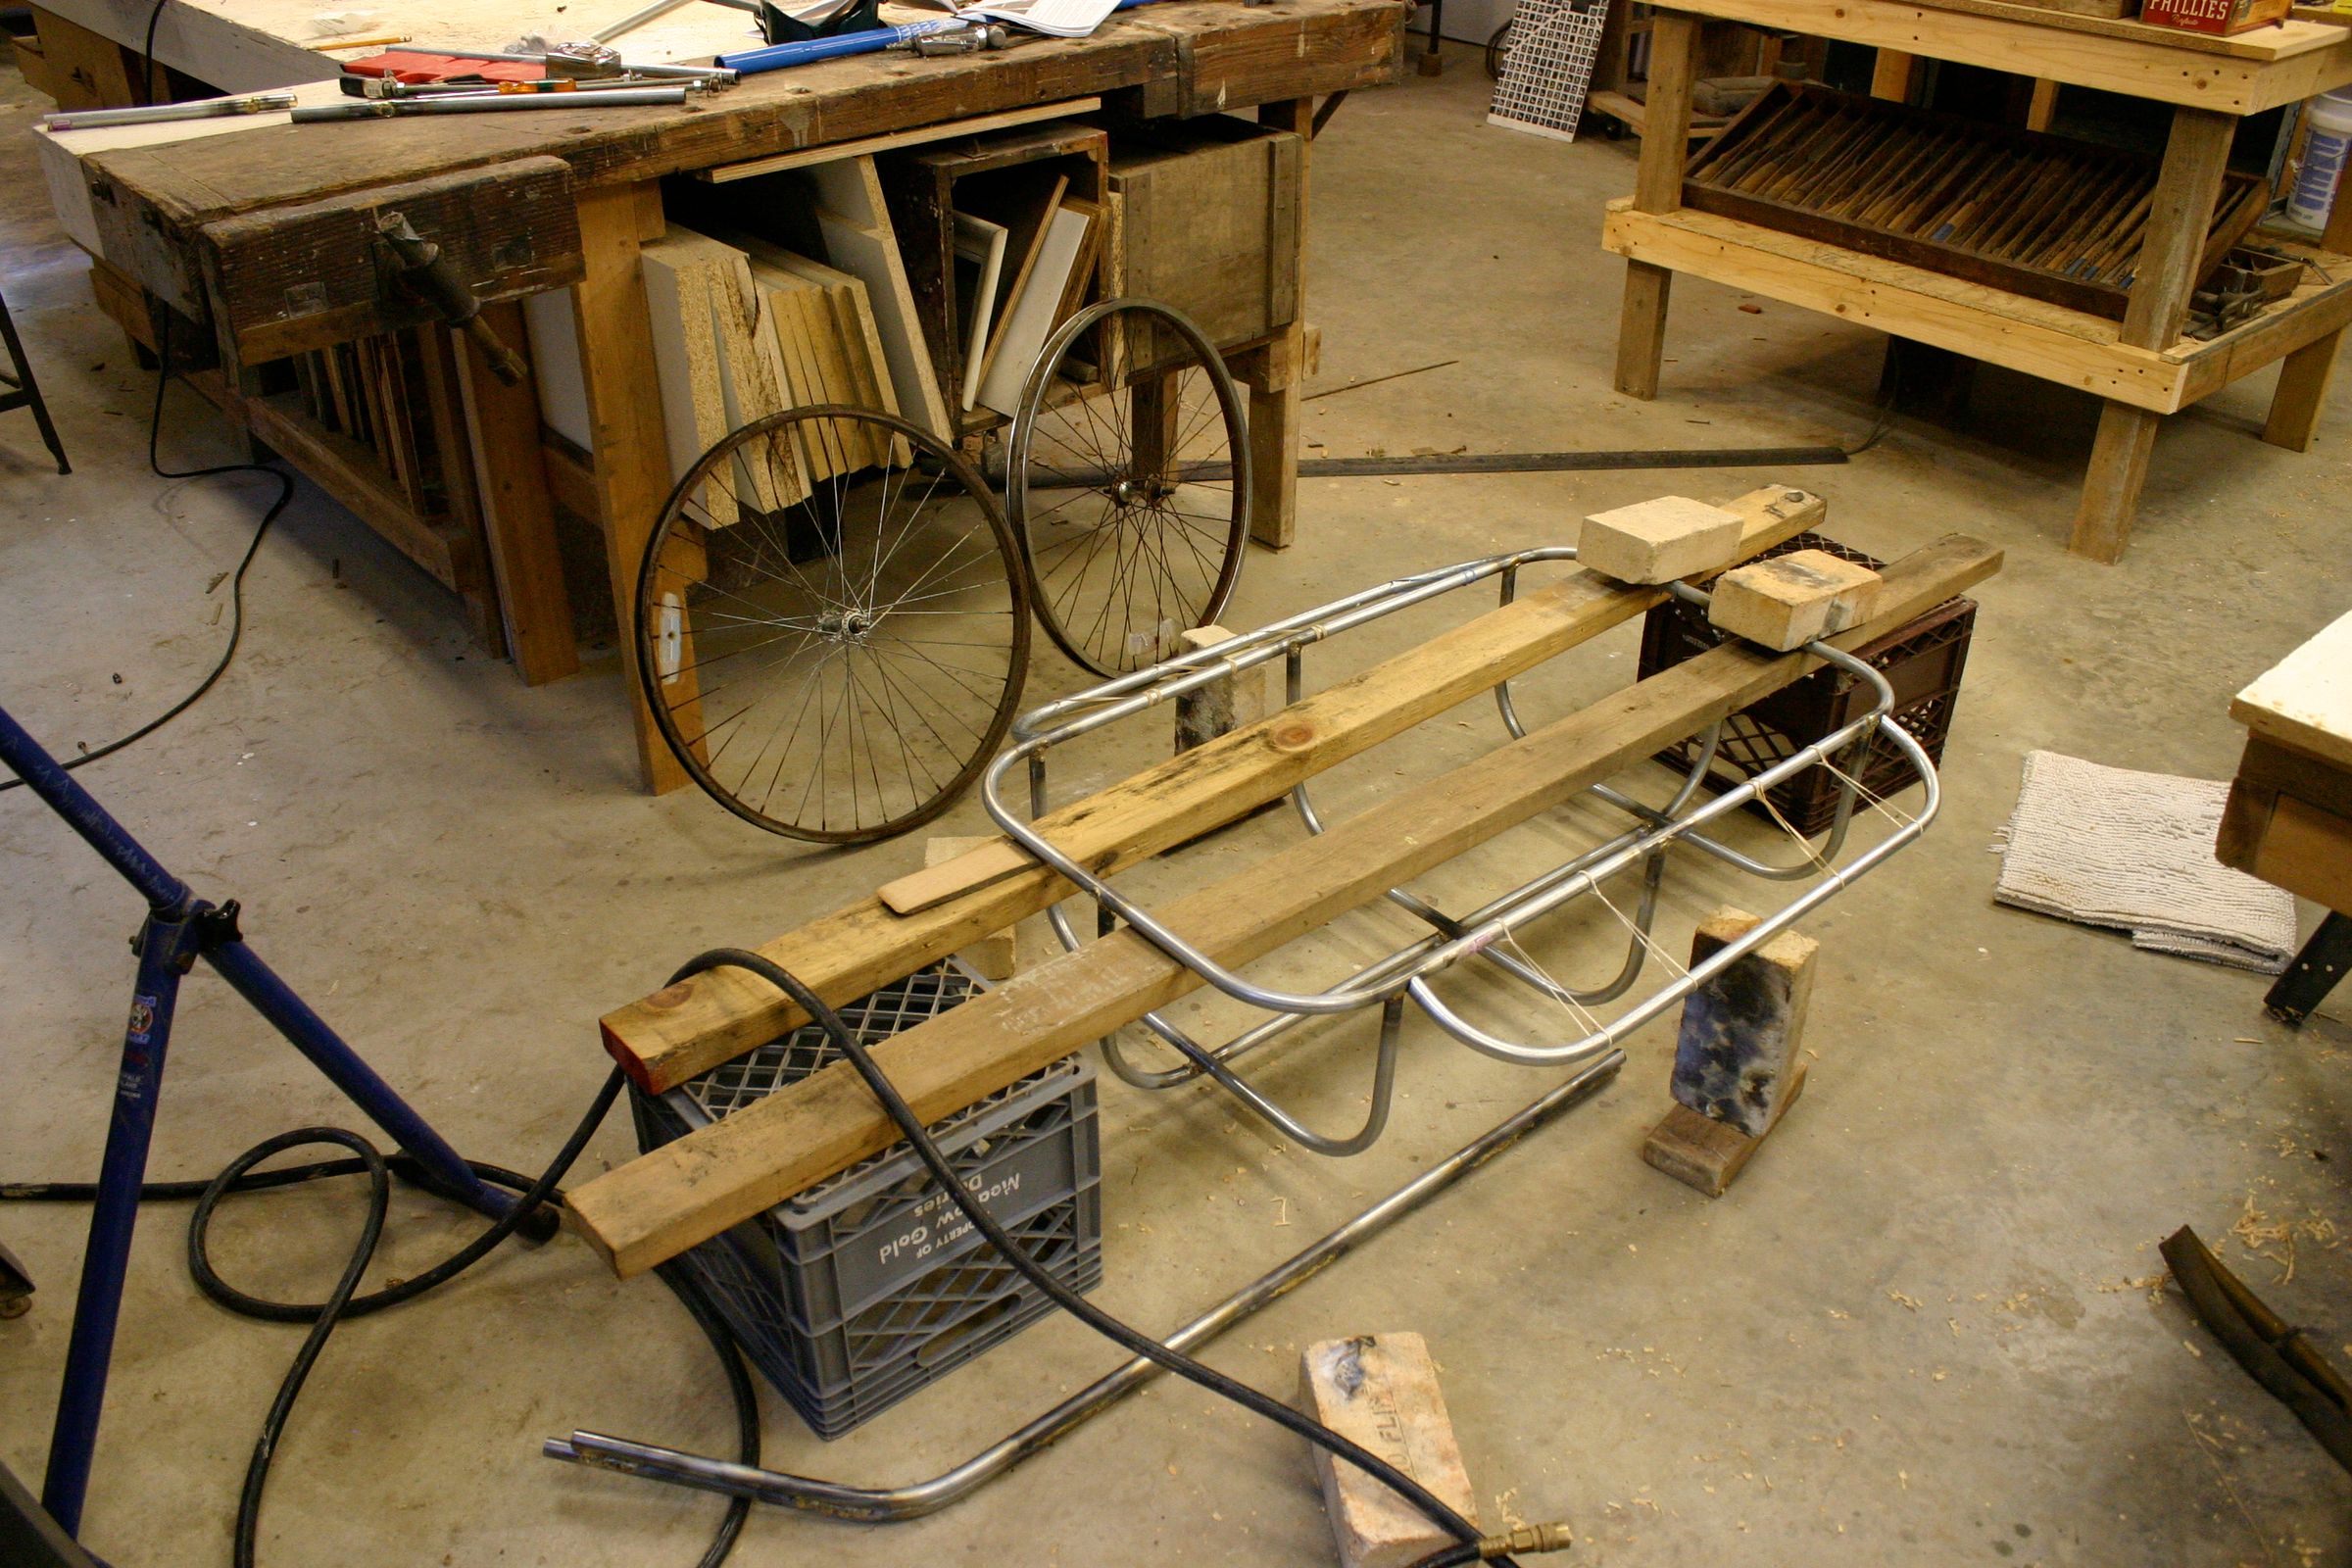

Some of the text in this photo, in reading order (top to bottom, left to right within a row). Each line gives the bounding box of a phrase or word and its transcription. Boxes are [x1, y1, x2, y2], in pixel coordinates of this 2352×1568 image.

[913, 1173, 983, 1217] Dries
[879, 1172, 1020, 1264] Meaow Gold
[915, 1244, 932, 1259] OF
